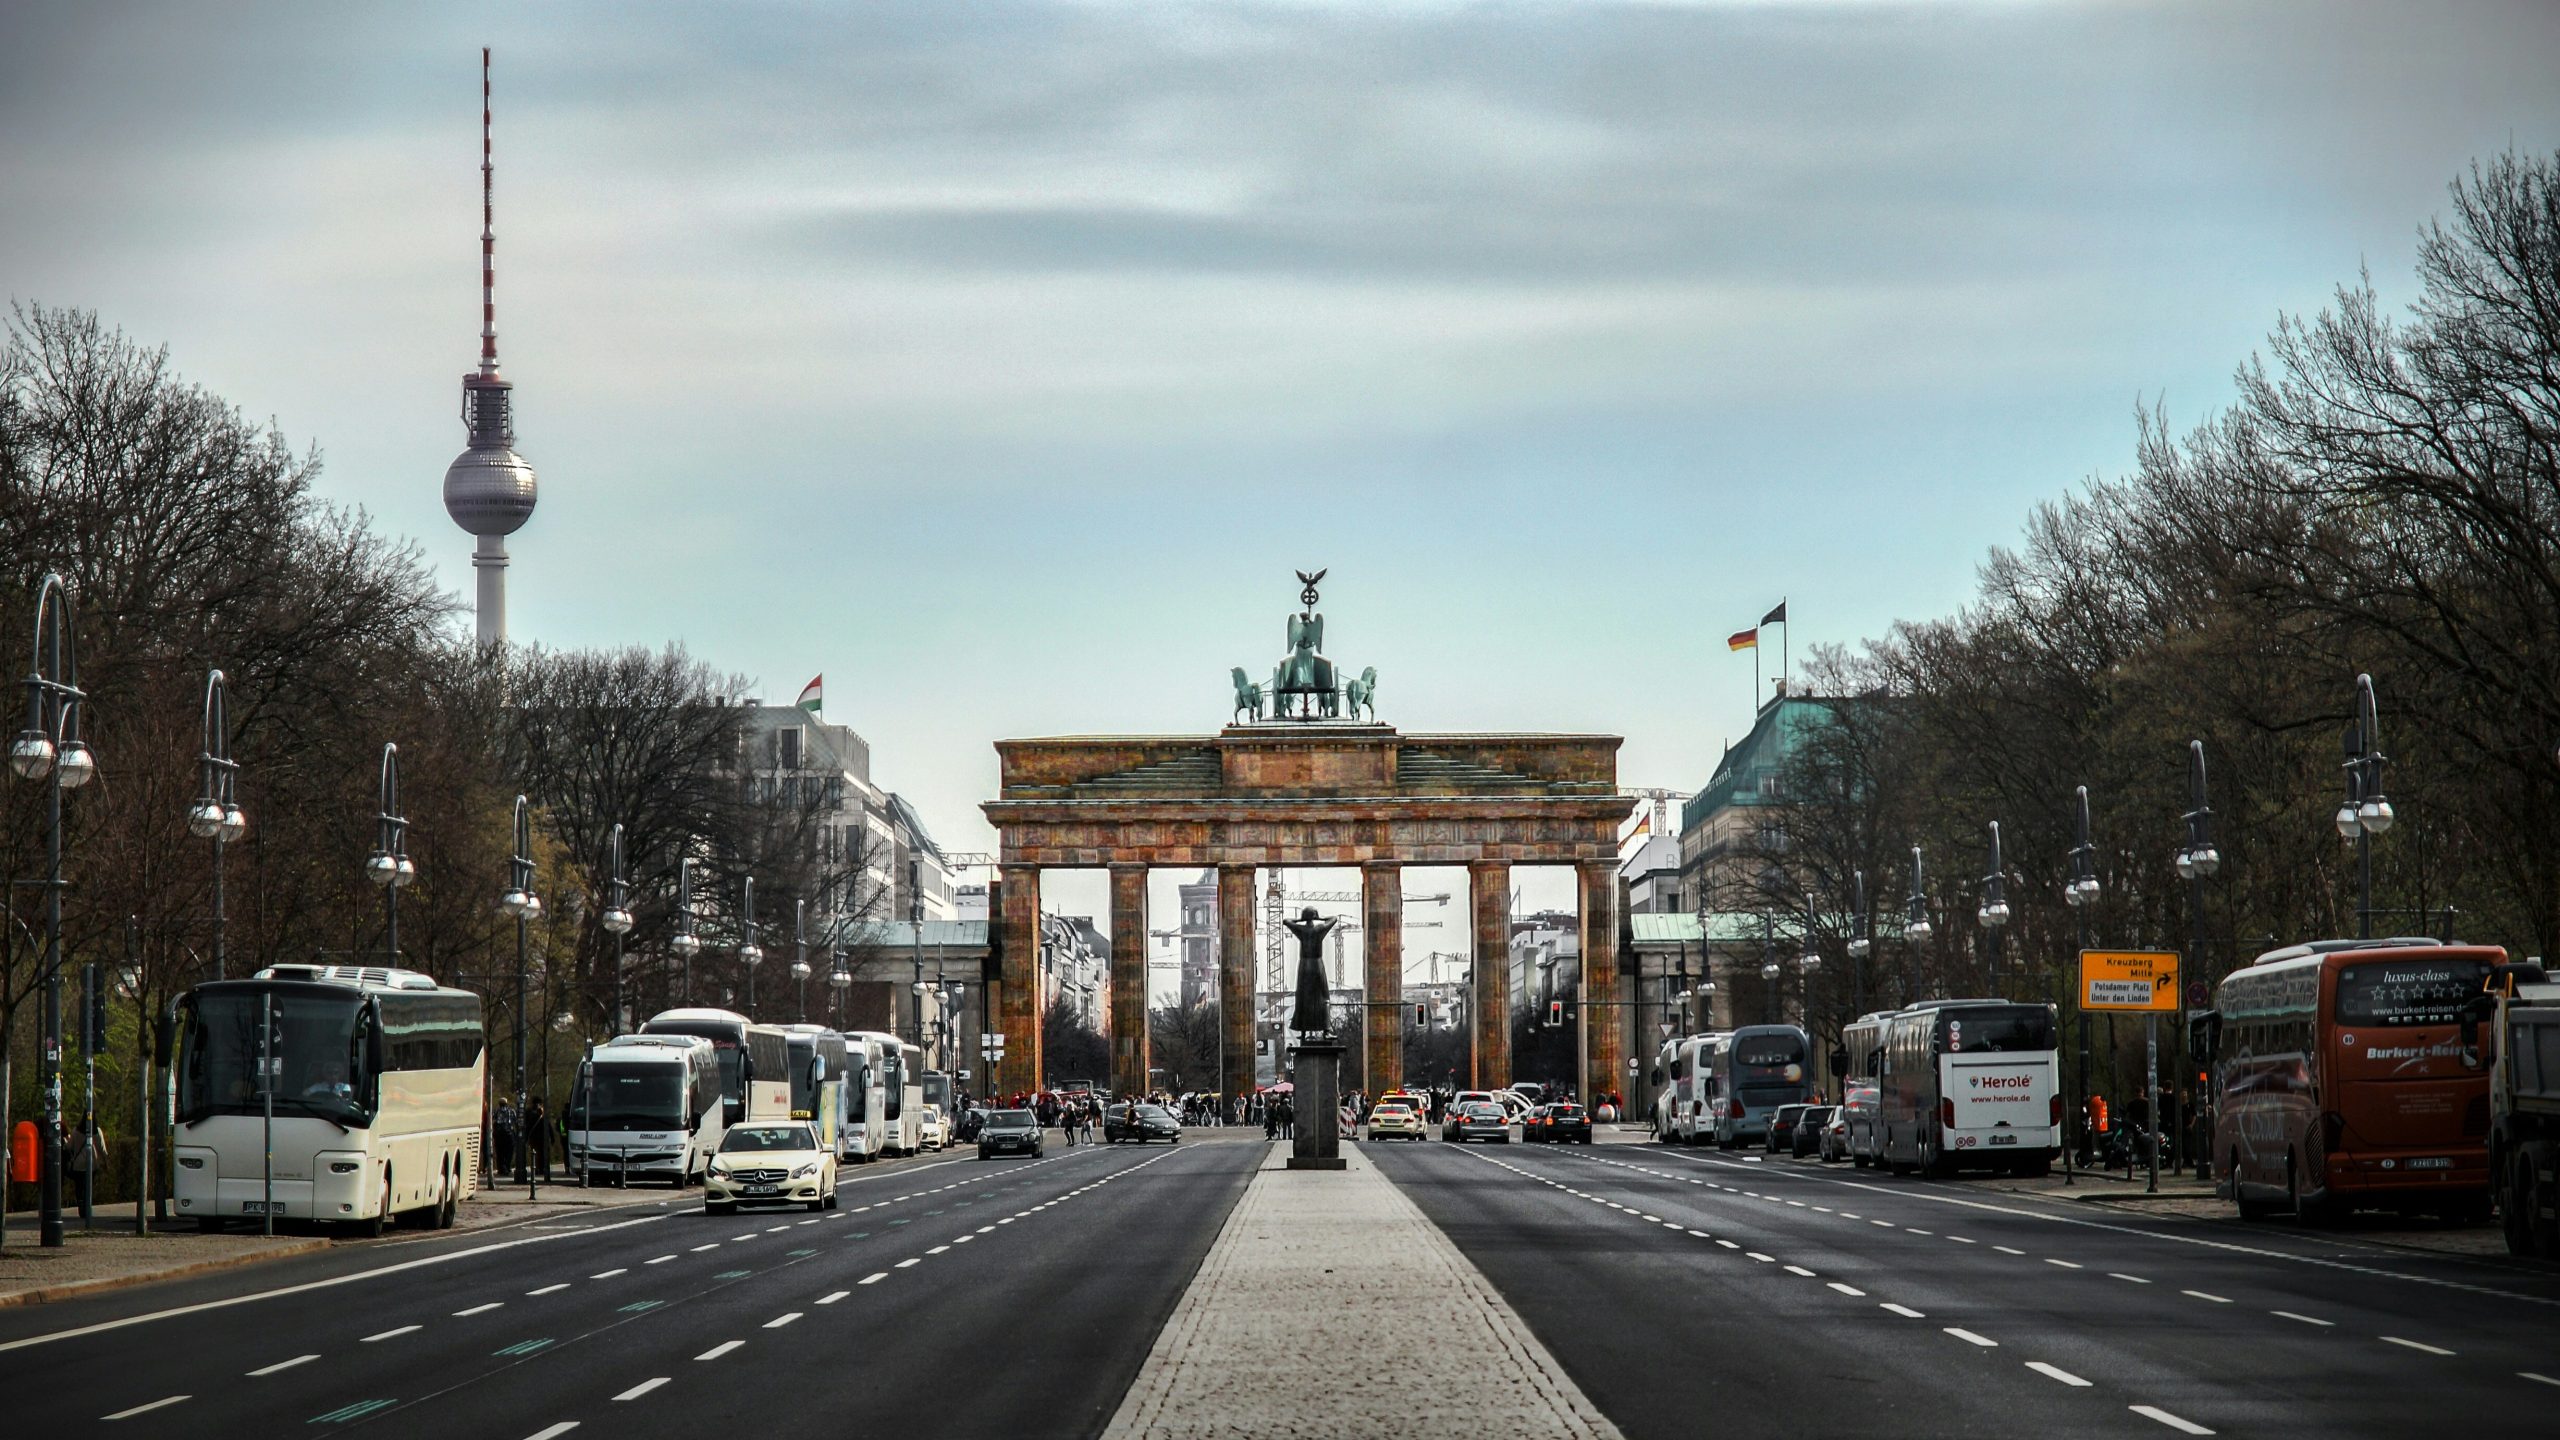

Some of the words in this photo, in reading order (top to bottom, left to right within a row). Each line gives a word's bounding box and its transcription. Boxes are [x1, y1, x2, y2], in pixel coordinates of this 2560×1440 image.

[2106, 958, 2153, 968] Kreuzberg
[2130, 969, 2153, 977] Mitte
[2383, 969, 2450, 983] luxus-class
[2094, 982, 2130, 991] Potsdamer
[2133, 982, 2149, 991] Platz
[2091, 993, 2109, 1002] Unter
[2112, 994, 2125, 1002] den
[2127, 994, 2150, 1003] Linden
[2371, 1004, 2463, 1016] www.burkert-reisen.d
[2388, 1014, 2454, 1023] SETRA
[1970, 1094, 2031, 1104] www.herole.de
